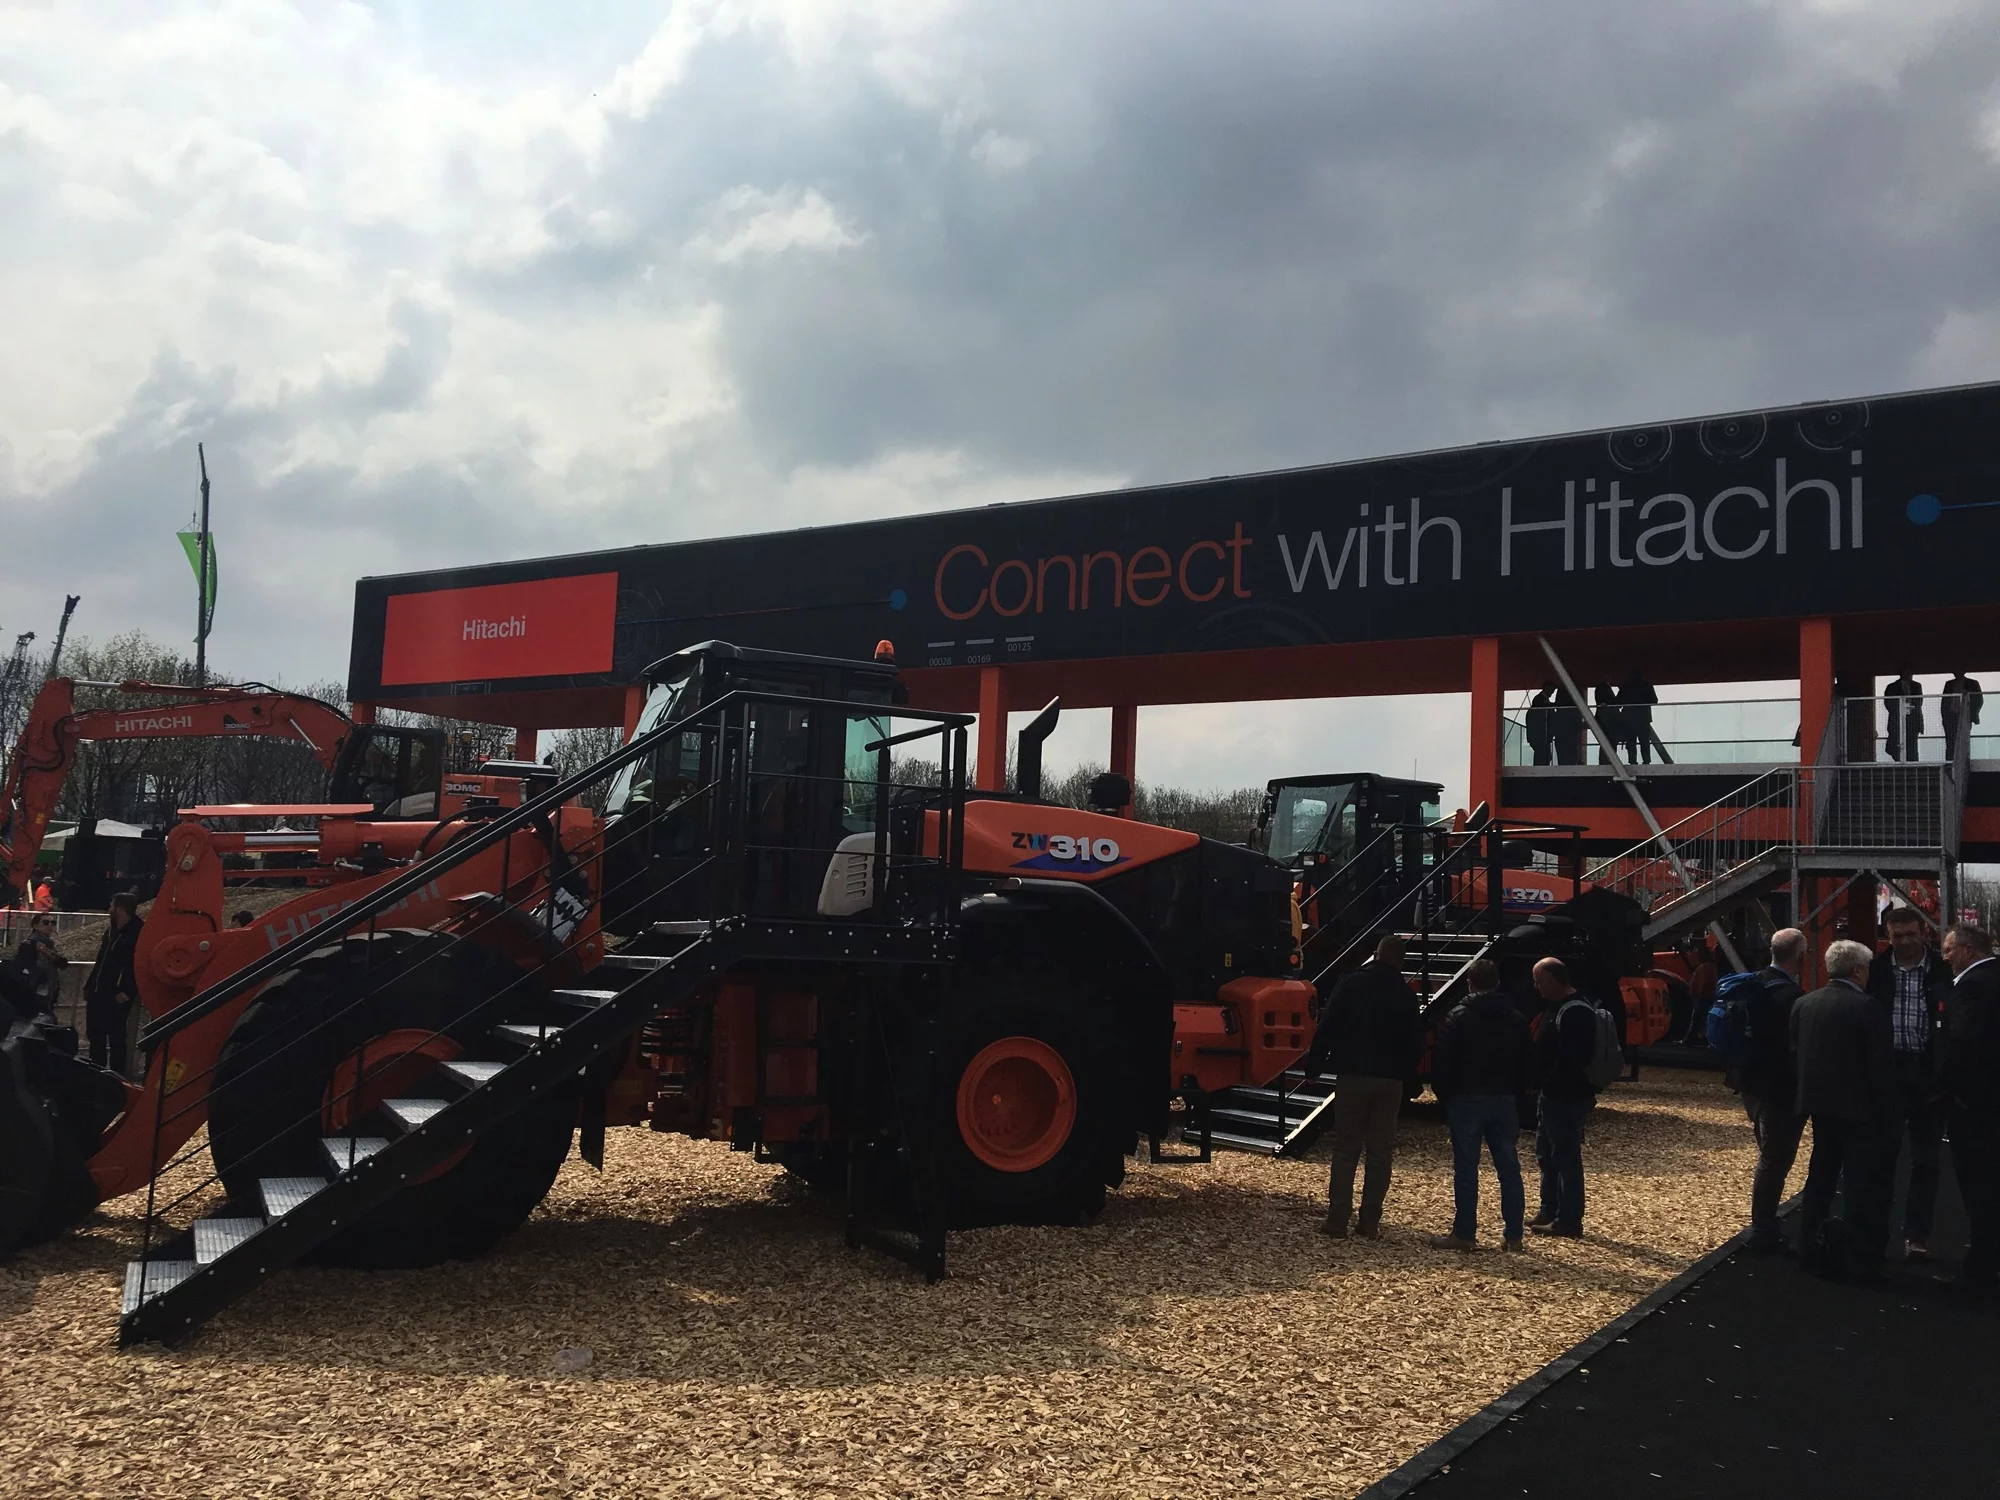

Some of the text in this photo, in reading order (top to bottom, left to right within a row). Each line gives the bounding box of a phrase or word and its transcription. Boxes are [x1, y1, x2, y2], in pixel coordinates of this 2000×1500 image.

[935, 450, 1863, 620] Connect with Hitachi
[462, 615, 526, 640] Hitachi
[1007, 642, 1032, 652] 00125
[928, 657, 952, 666] 00028
[967, 655, 991, 664] 00169
[115, 715, 192, 732] HITACHI
[445, 783, 481, 793] 3DMC
